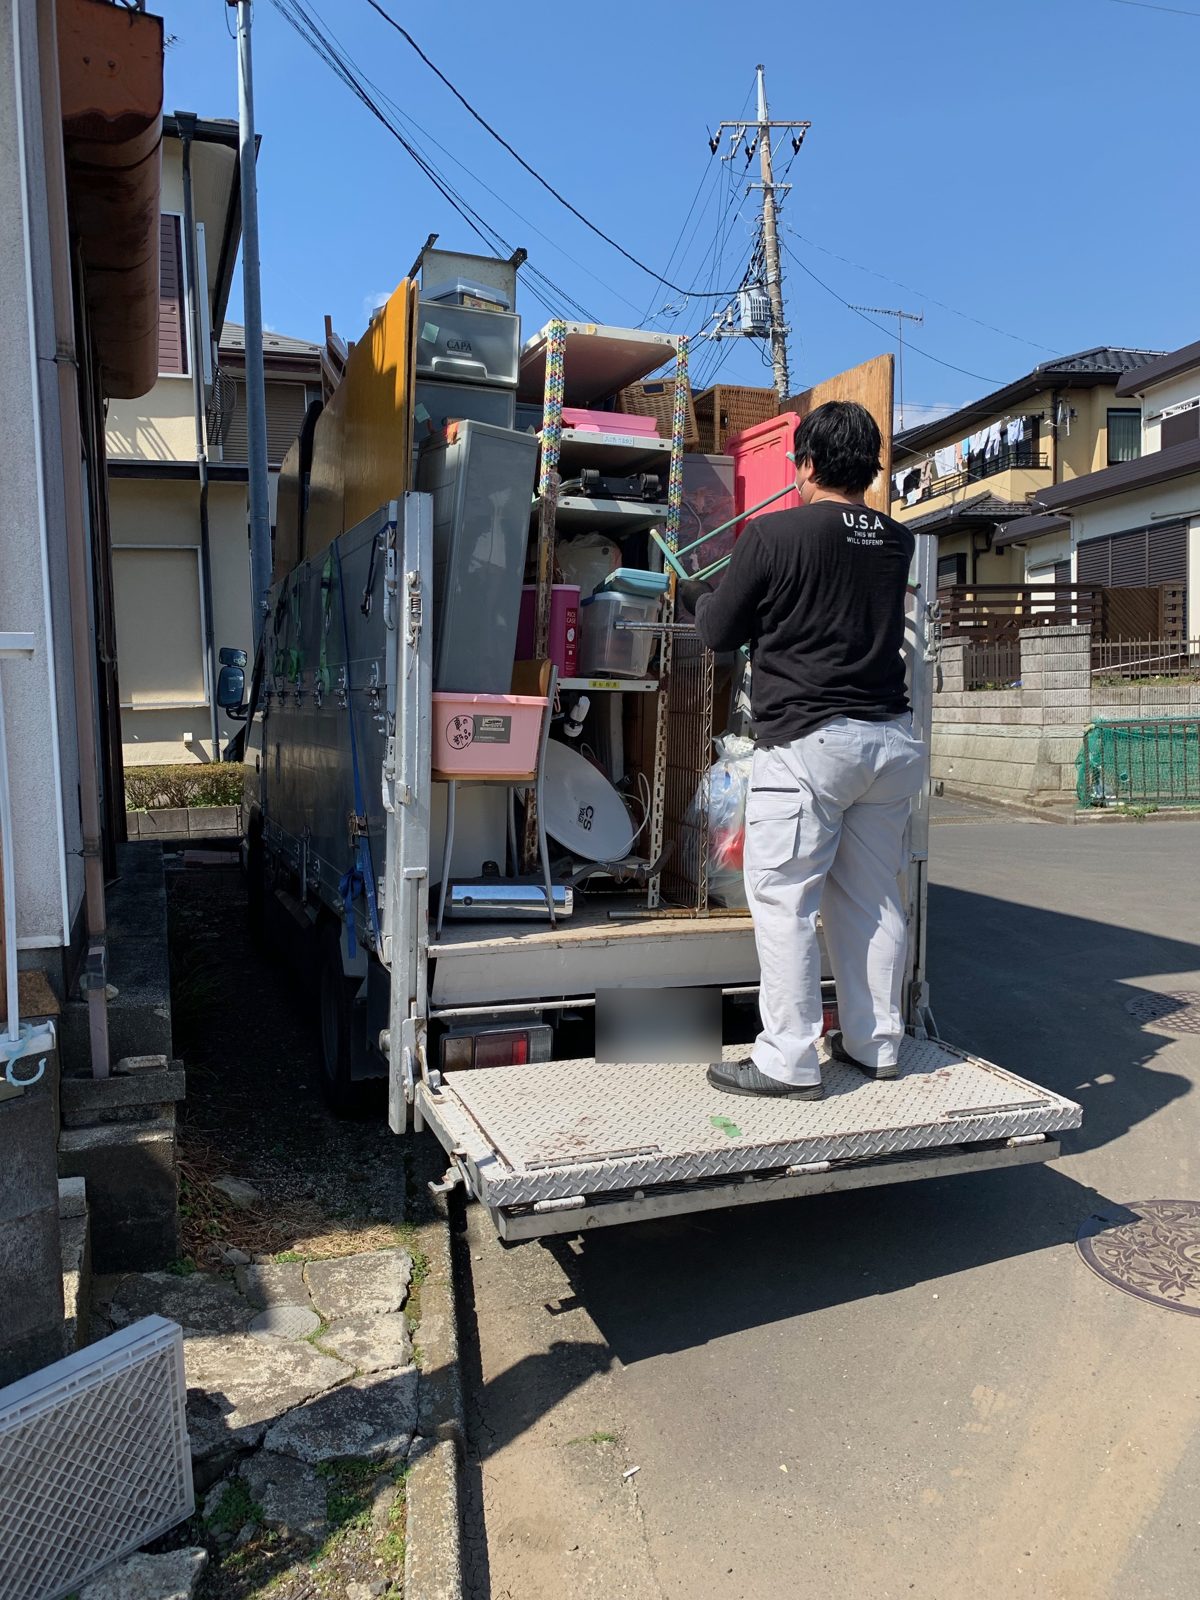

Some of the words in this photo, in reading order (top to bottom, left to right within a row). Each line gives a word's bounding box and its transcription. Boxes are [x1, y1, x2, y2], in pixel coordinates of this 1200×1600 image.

[446, 338, 472, 351] CAPA
[842, 512, 885, 530] U.S.A
[846, 536, 860, 545] WILL
[583, 805, 594, 831] CS
